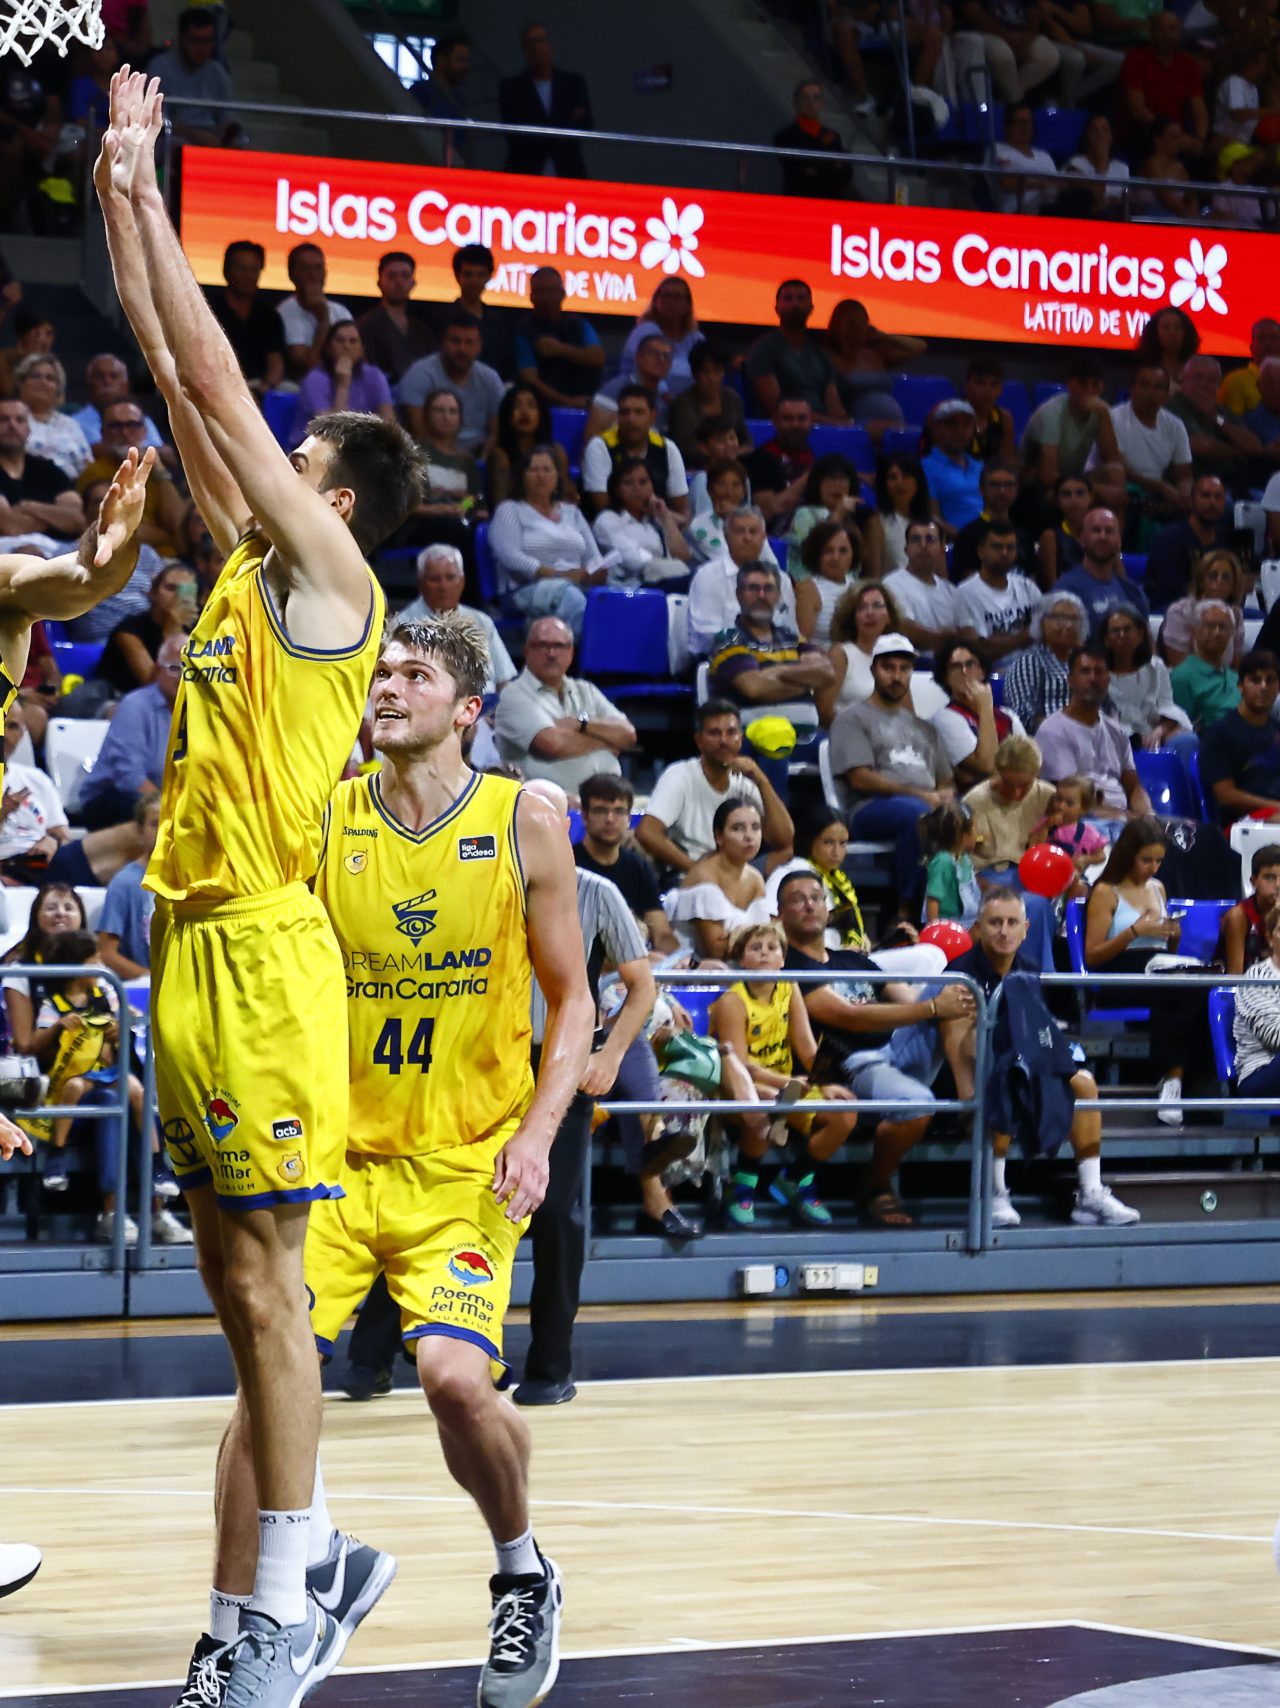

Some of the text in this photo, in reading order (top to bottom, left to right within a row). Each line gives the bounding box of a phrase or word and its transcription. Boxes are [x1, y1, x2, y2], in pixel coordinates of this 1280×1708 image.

[276, 179, 637, 261] Islas Canarias
[831, 224, 1166, 299] Islas Canarias
[565, 270, 590, 298] DE
[592, 270, 637, 303] VIDA
[1024, 301, 1151, 339] LATITUD DE VI
[343, 826, 379, 838] SPALDING
[461, 848, 494, 858] endesa
[396, 973, 489, 1000] Canaria
[373, 1017, 436, 1075] 44
[275, 1126, 298, 1137] acb
[428, 1301, 493, 1324] del Mar
[431, 1286, 495, 1312] Poema
